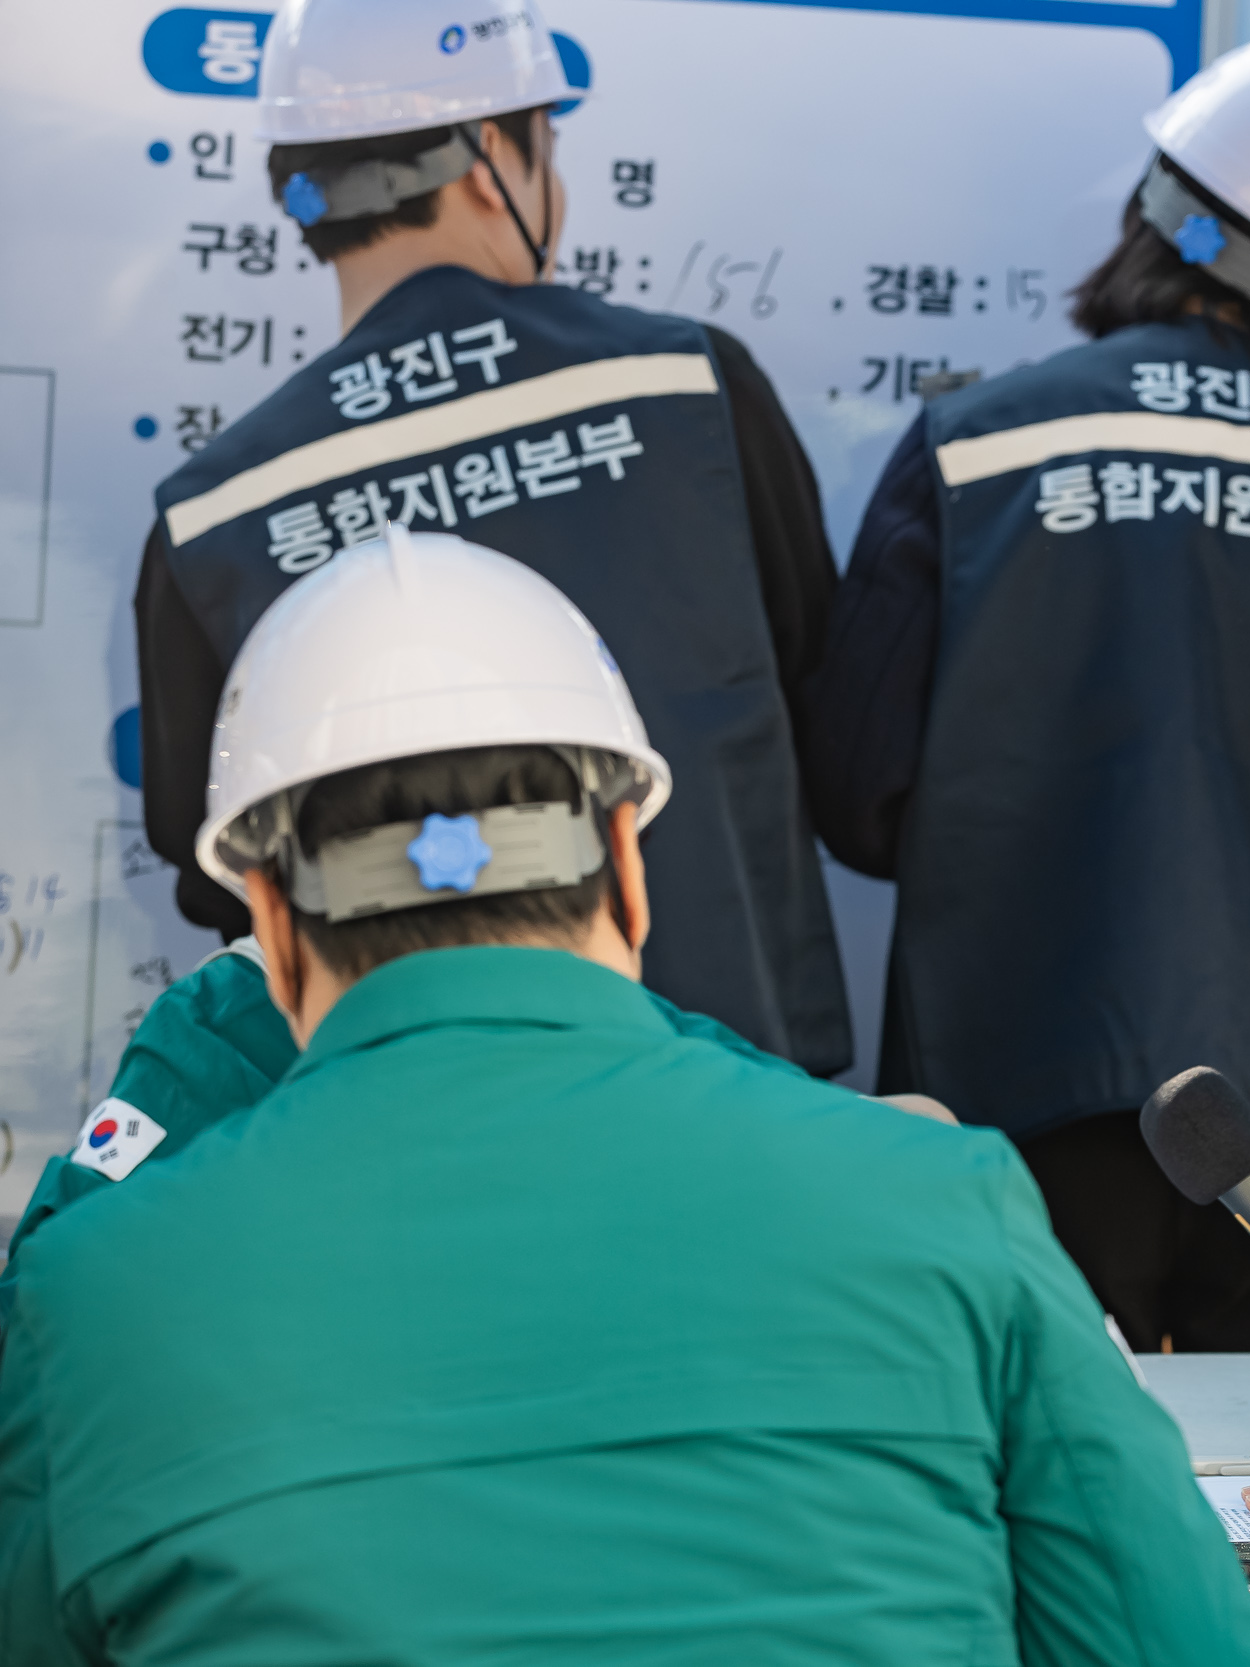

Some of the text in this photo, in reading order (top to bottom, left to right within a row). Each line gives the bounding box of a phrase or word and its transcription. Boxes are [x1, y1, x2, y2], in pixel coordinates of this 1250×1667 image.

[613, 159, 655, 209] 명
[329, 318, 518, 419] 광진구
[267, 413, 644, 573] 통합지원본부
